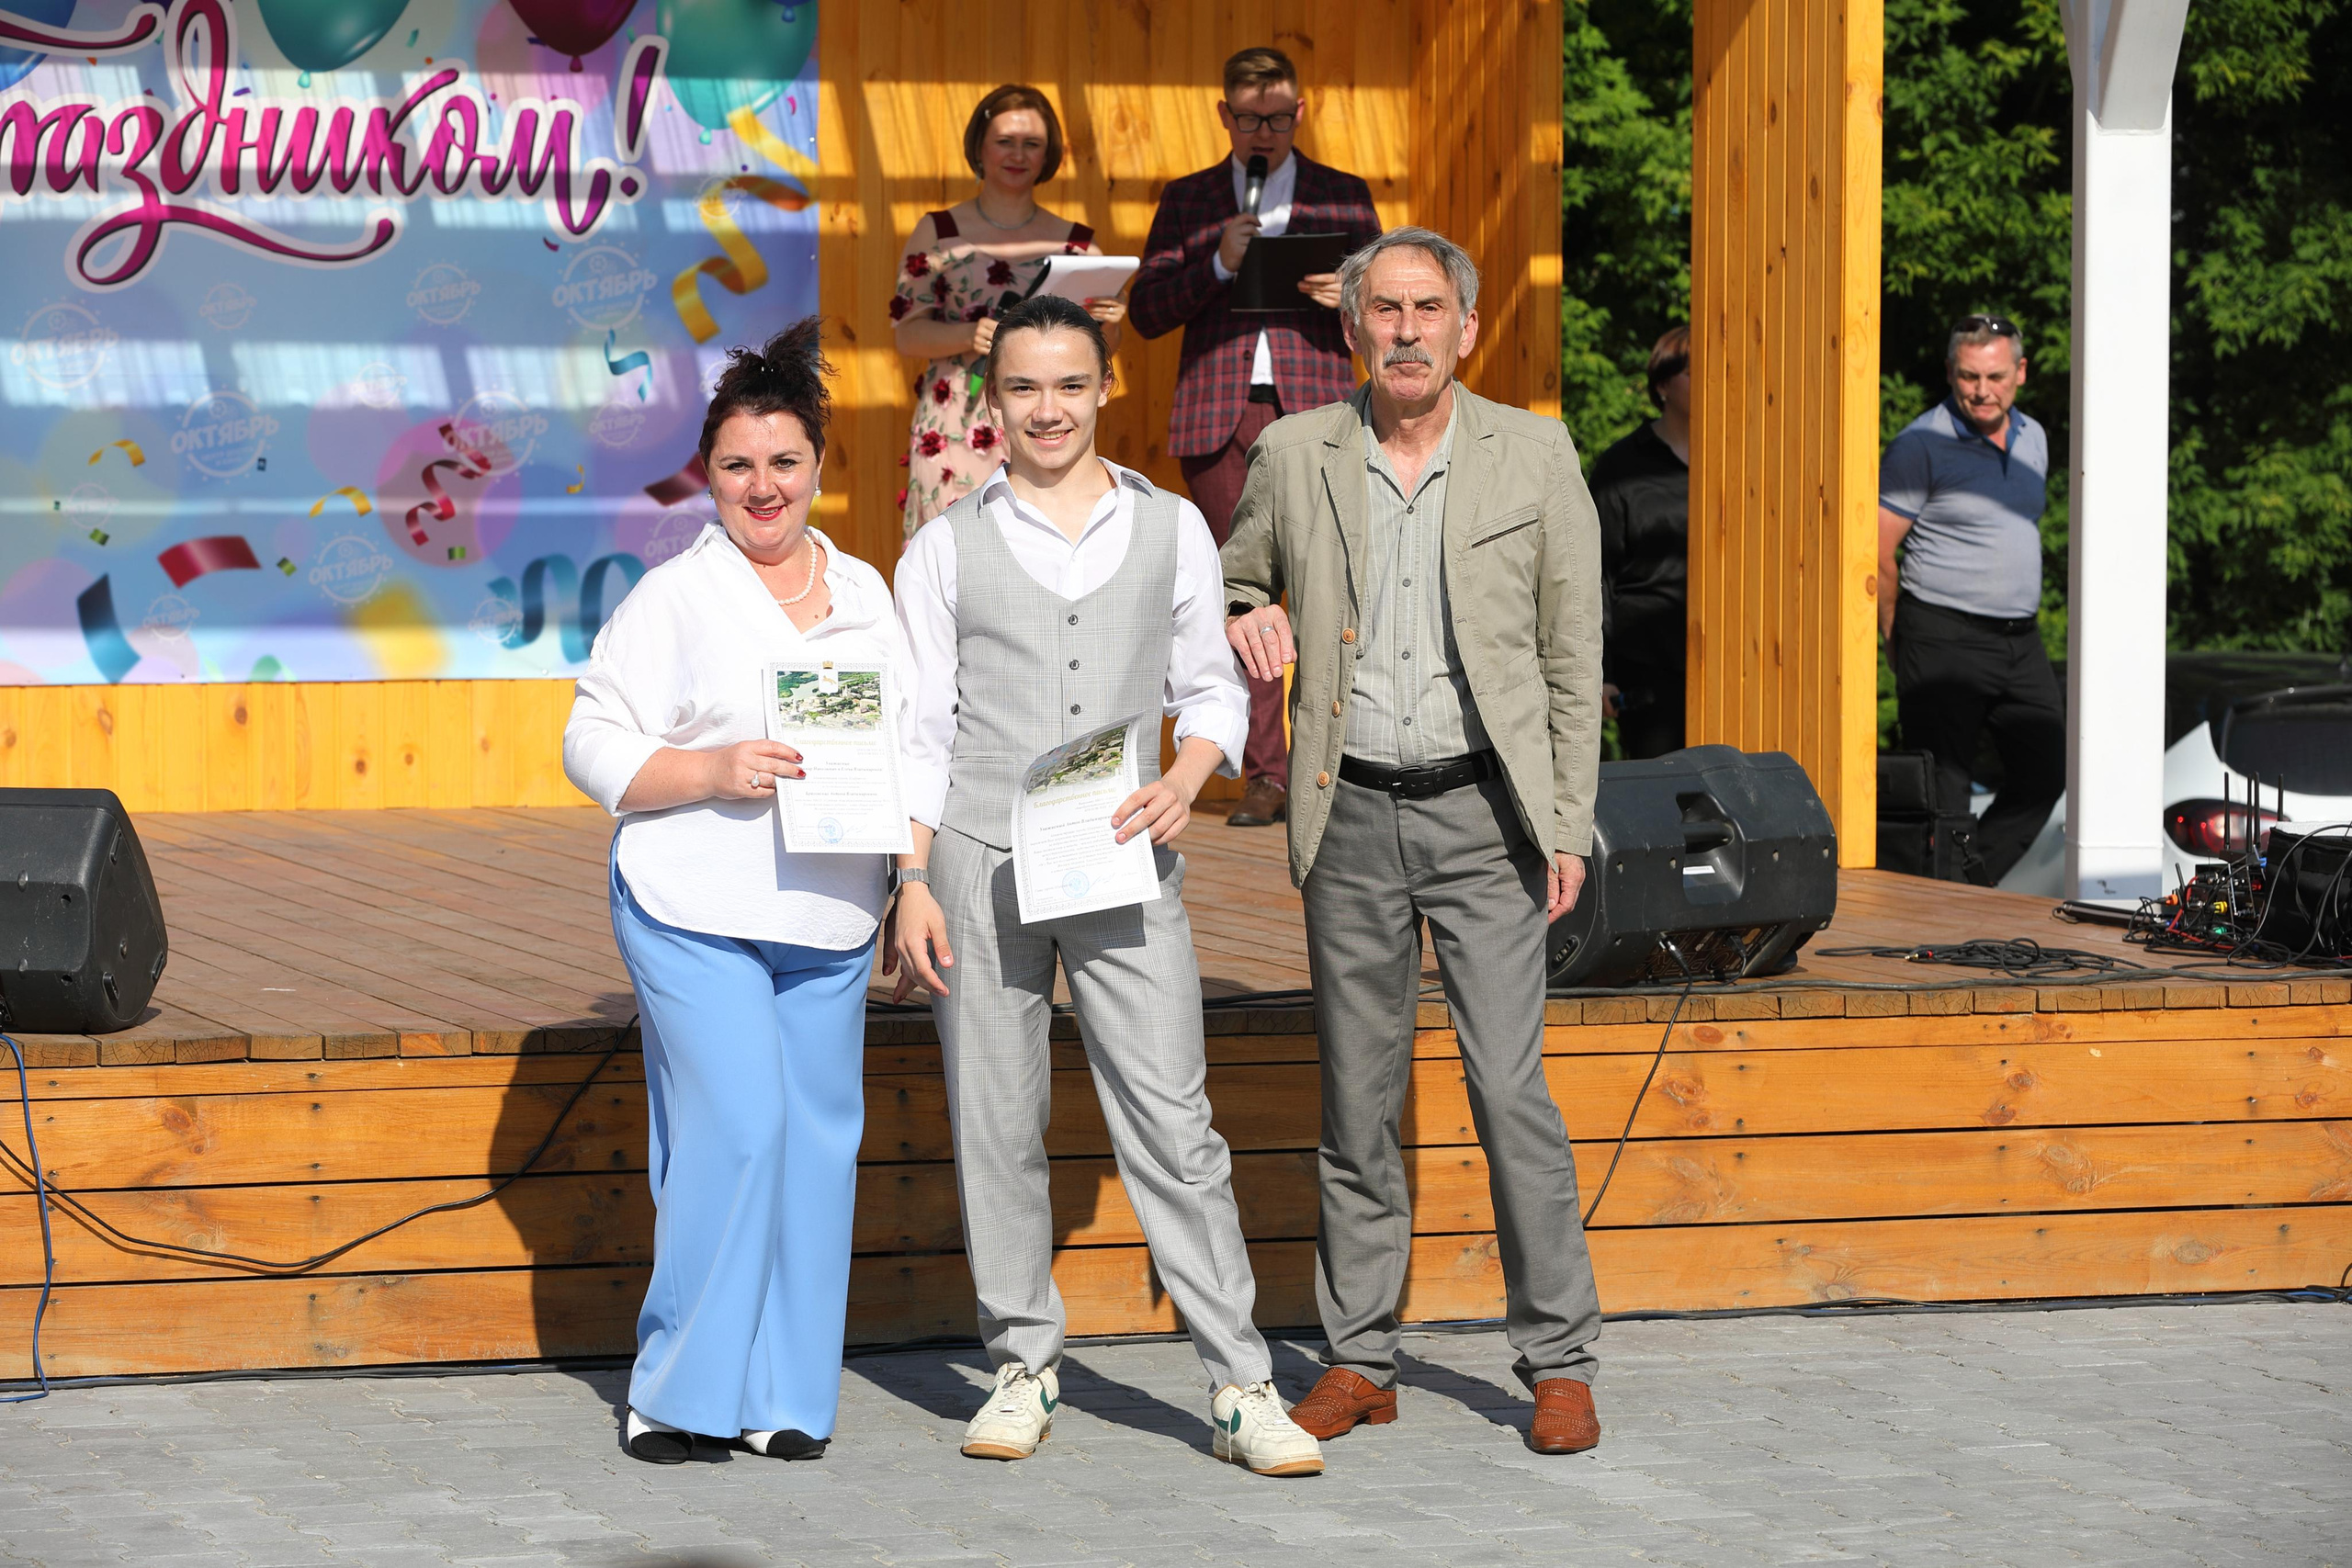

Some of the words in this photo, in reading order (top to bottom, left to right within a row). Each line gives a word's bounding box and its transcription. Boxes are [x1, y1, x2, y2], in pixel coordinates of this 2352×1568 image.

[405, 279, 481, 308] ОКТЯБРЬ
[551, 267, 659, 308] ОКТЯБРЬ
[10, 326, 119, 366] ОКТЯБРЬ
[170, 414, 280, 455] ОКТЯБРЬ
[308, 553, 393, 585] ОКТЯБРЬ
[1033, 791, 1091, 808] Благодарственное
